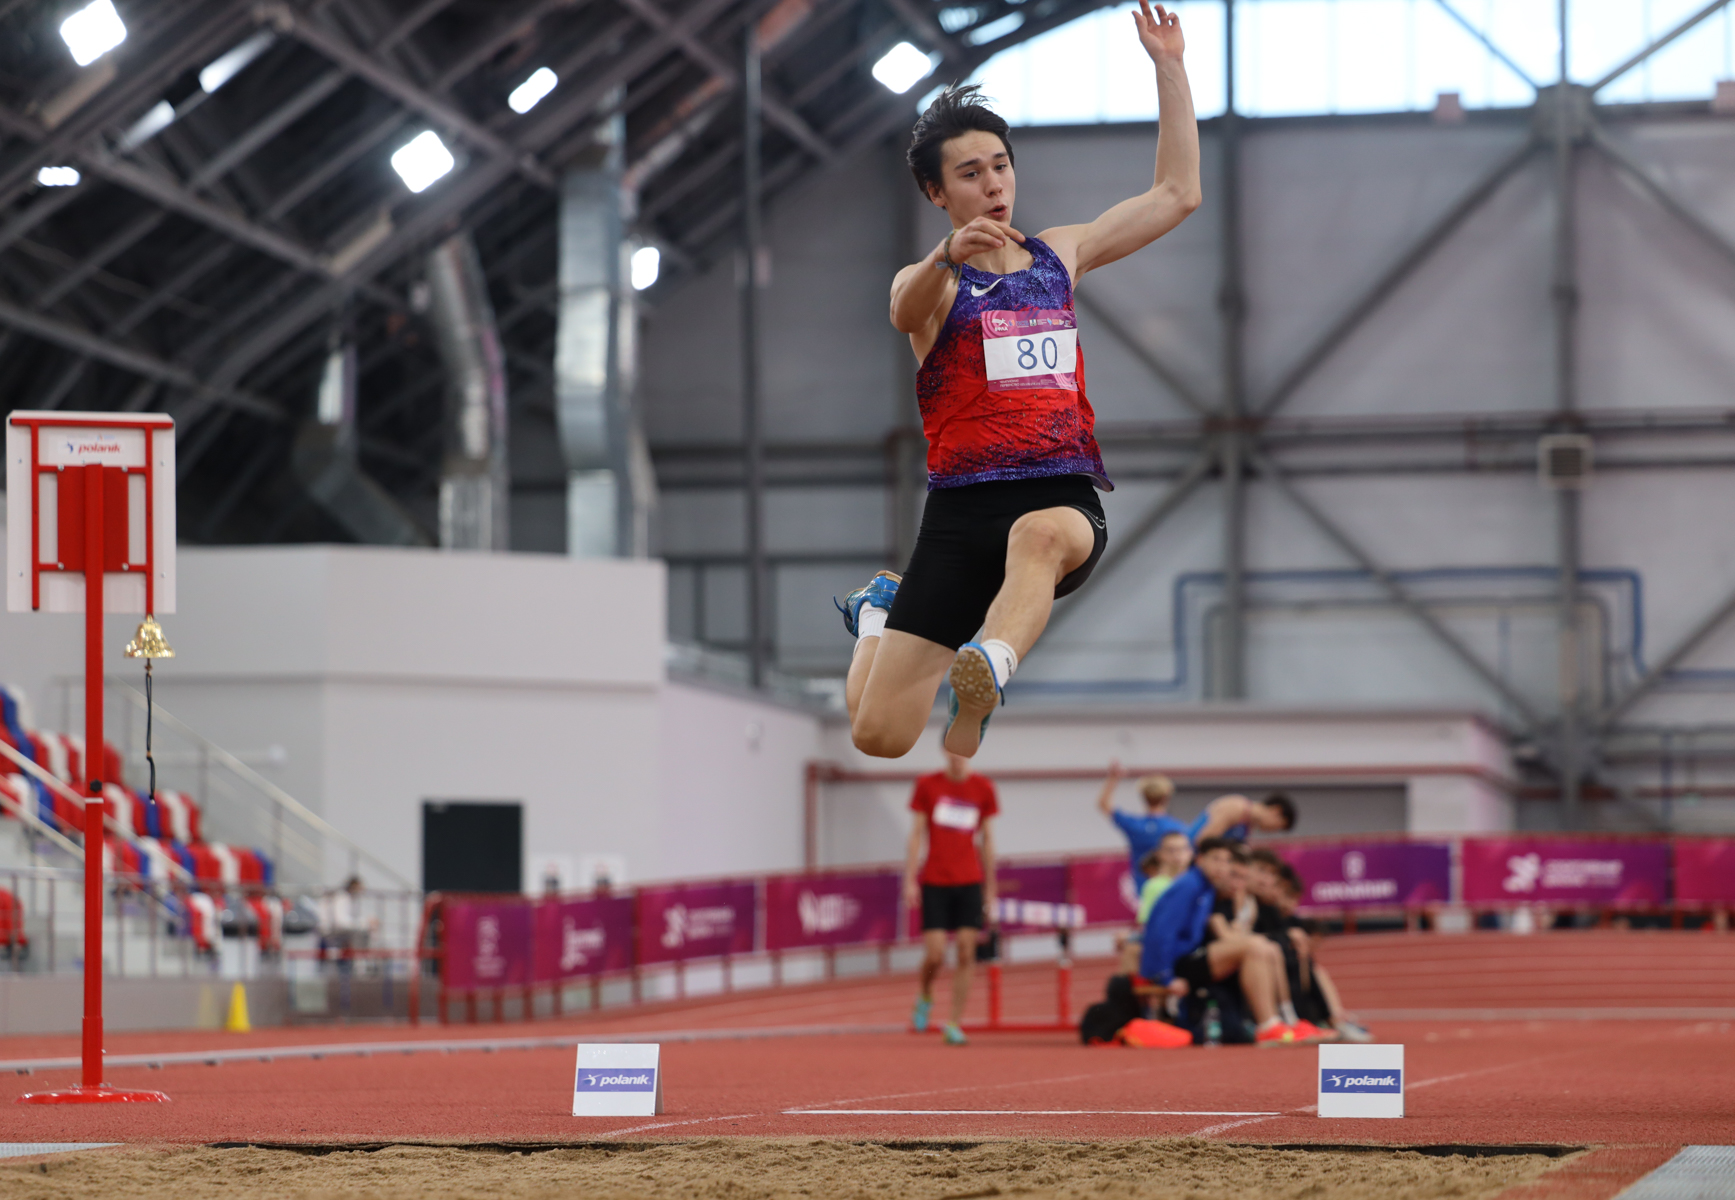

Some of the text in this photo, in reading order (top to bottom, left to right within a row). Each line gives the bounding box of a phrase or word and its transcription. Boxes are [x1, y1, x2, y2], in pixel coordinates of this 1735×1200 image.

[1016, 337, 1058, 370] 80
[78, 442, 121, 456] polanik
[599, 1074, 649, 1087] polanik
[1344, 1075, 1396, 1088] polanik
